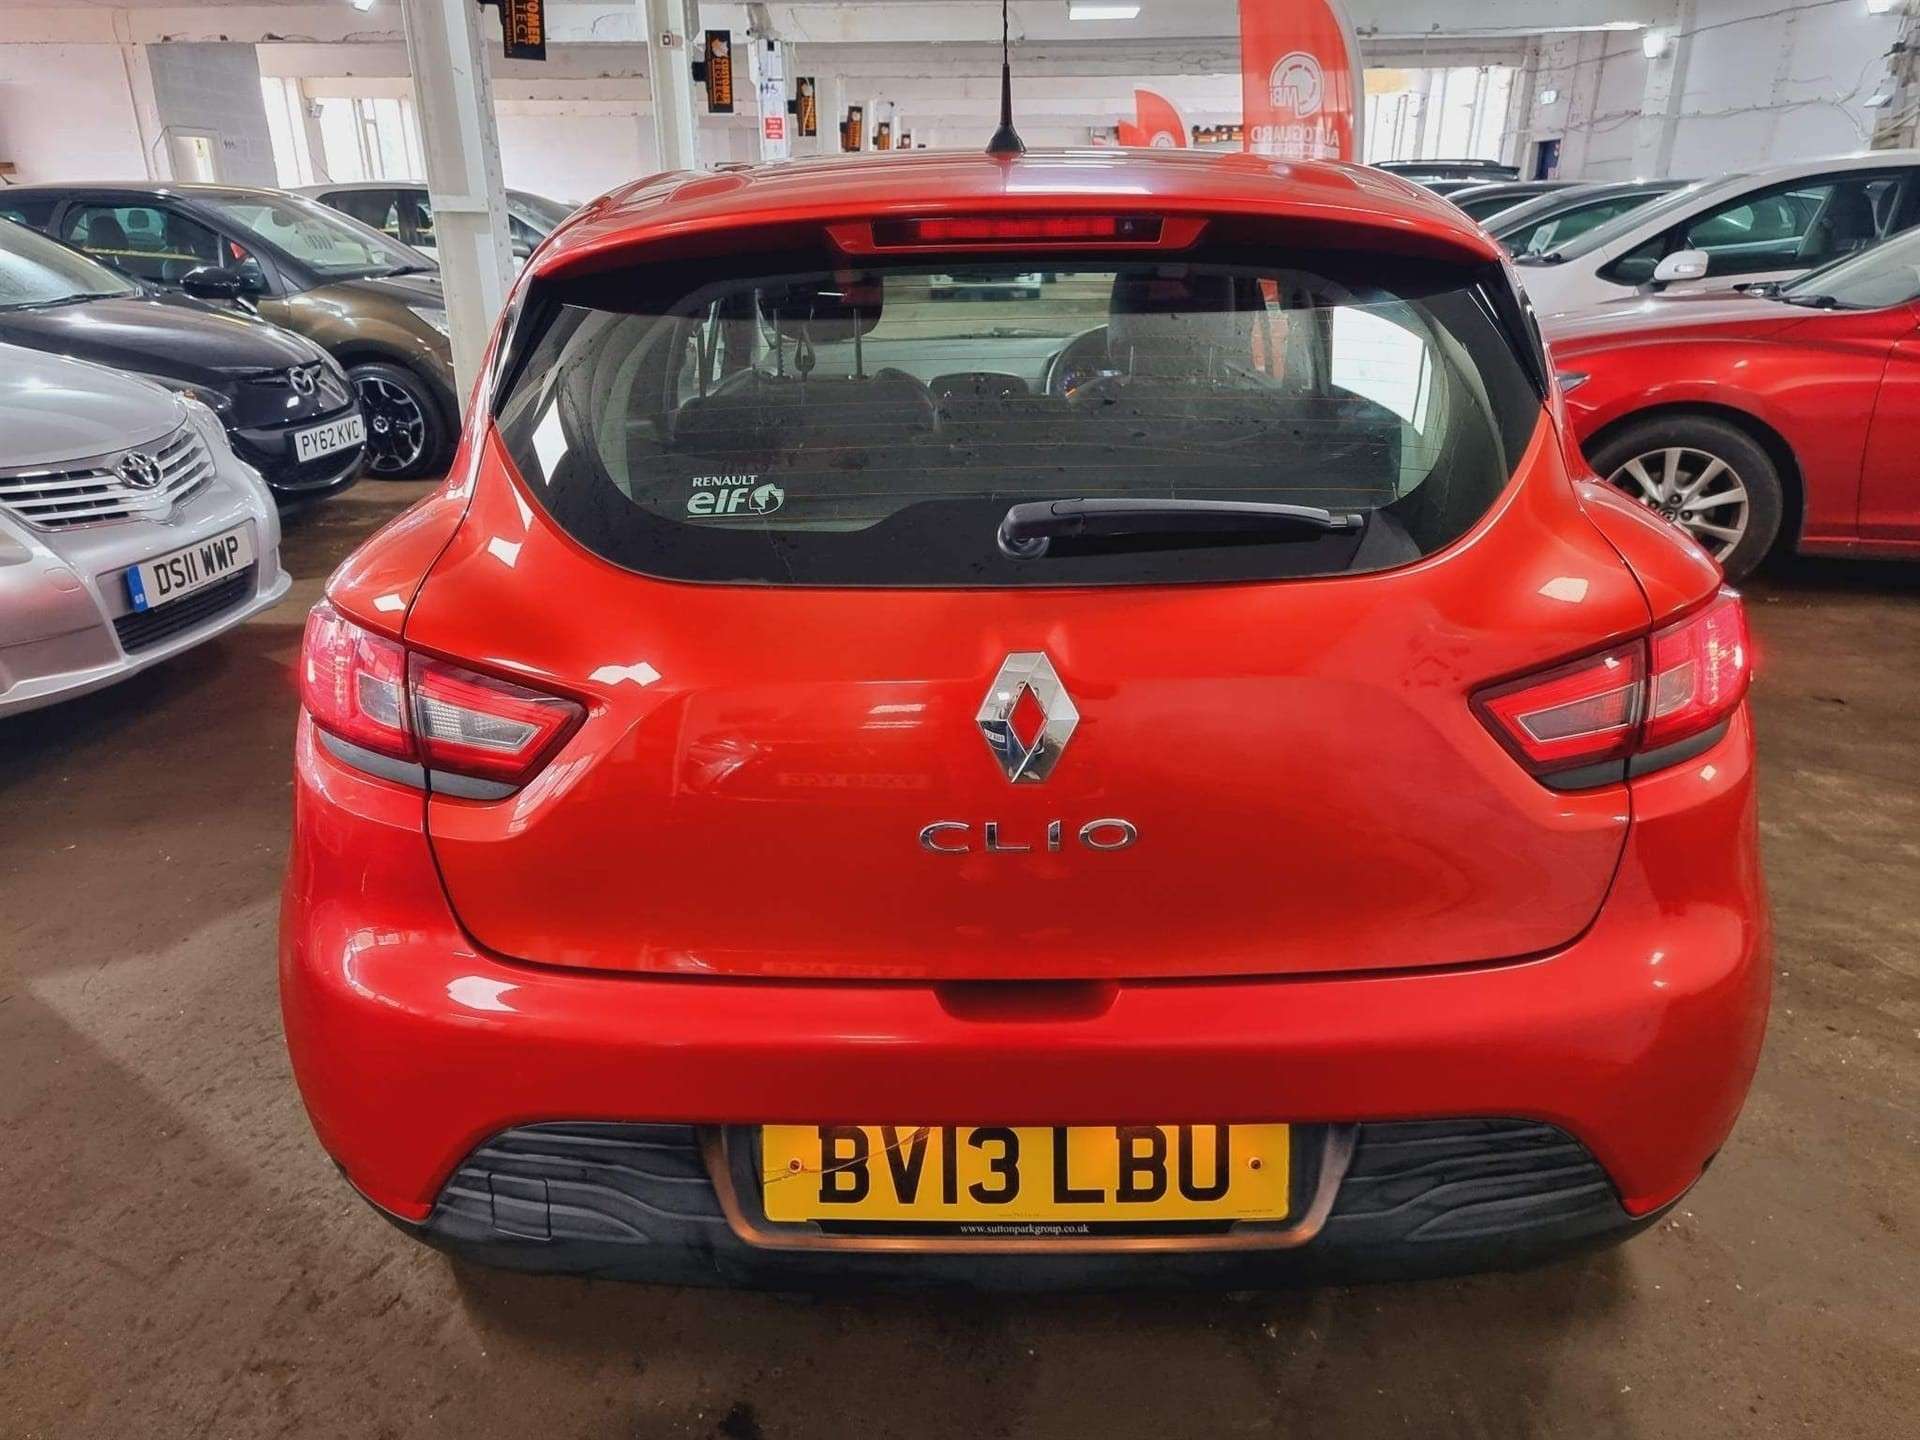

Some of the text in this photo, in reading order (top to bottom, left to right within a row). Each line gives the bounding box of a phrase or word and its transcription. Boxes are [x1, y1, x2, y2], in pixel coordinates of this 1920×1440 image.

[302, 420, 360, 456] PY62 KVC
[692, 474, 758, 487] RENAULT
[687, 488, 749, 514] elf
[153, 535, 239, 596] DS11 WWP
[919, 817, 1138, 852] CLIO
[818, 1124, 1231, 1204] BV13 LBU
[959, 1223, 1090, 1235] www.suttonparkgroup.co.uk
